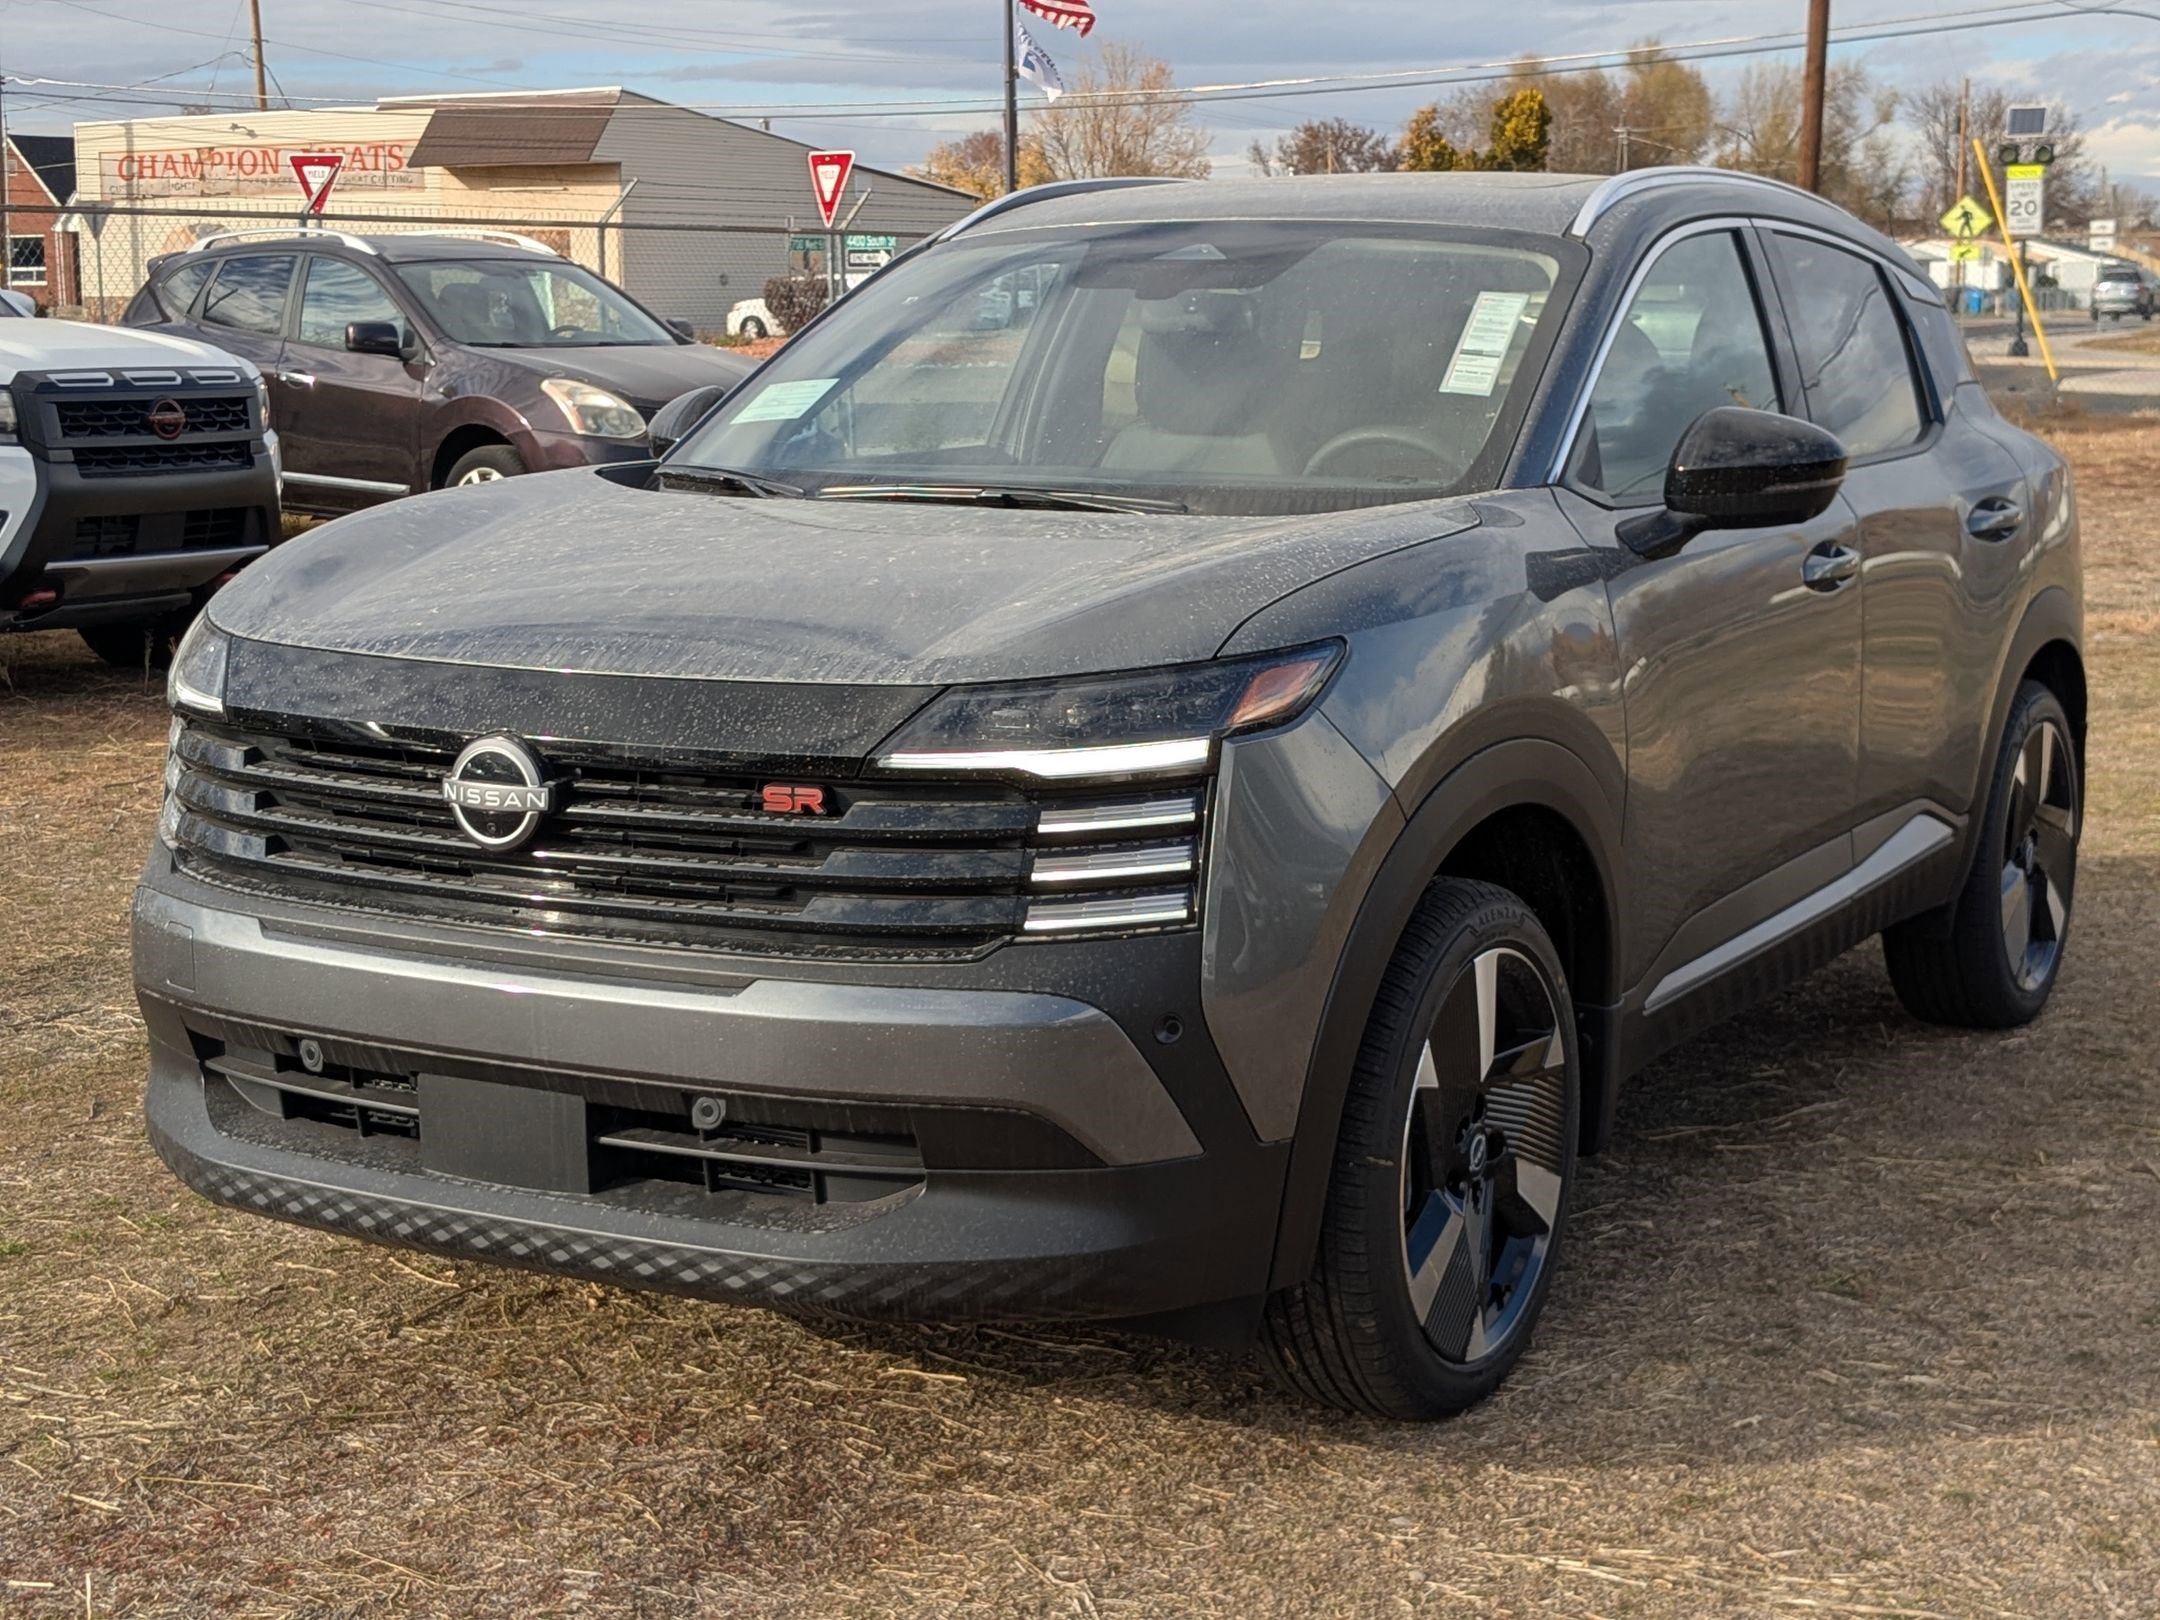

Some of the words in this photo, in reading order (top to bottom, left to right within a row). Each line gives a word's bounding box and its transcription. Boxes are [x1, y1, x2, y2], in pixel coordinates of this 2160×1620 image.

[118, 149, 281, 182] CHAMPION
[301, 145, 404, 172] ATS
[307, 169, 326, 179] YIELD
[2010, 200, 2037, 217] 20
[444, 783, 546, 808] NISSAN
[763, 786, 825, 814] SR
[1478, 906, 1518, 926] ALENZA
